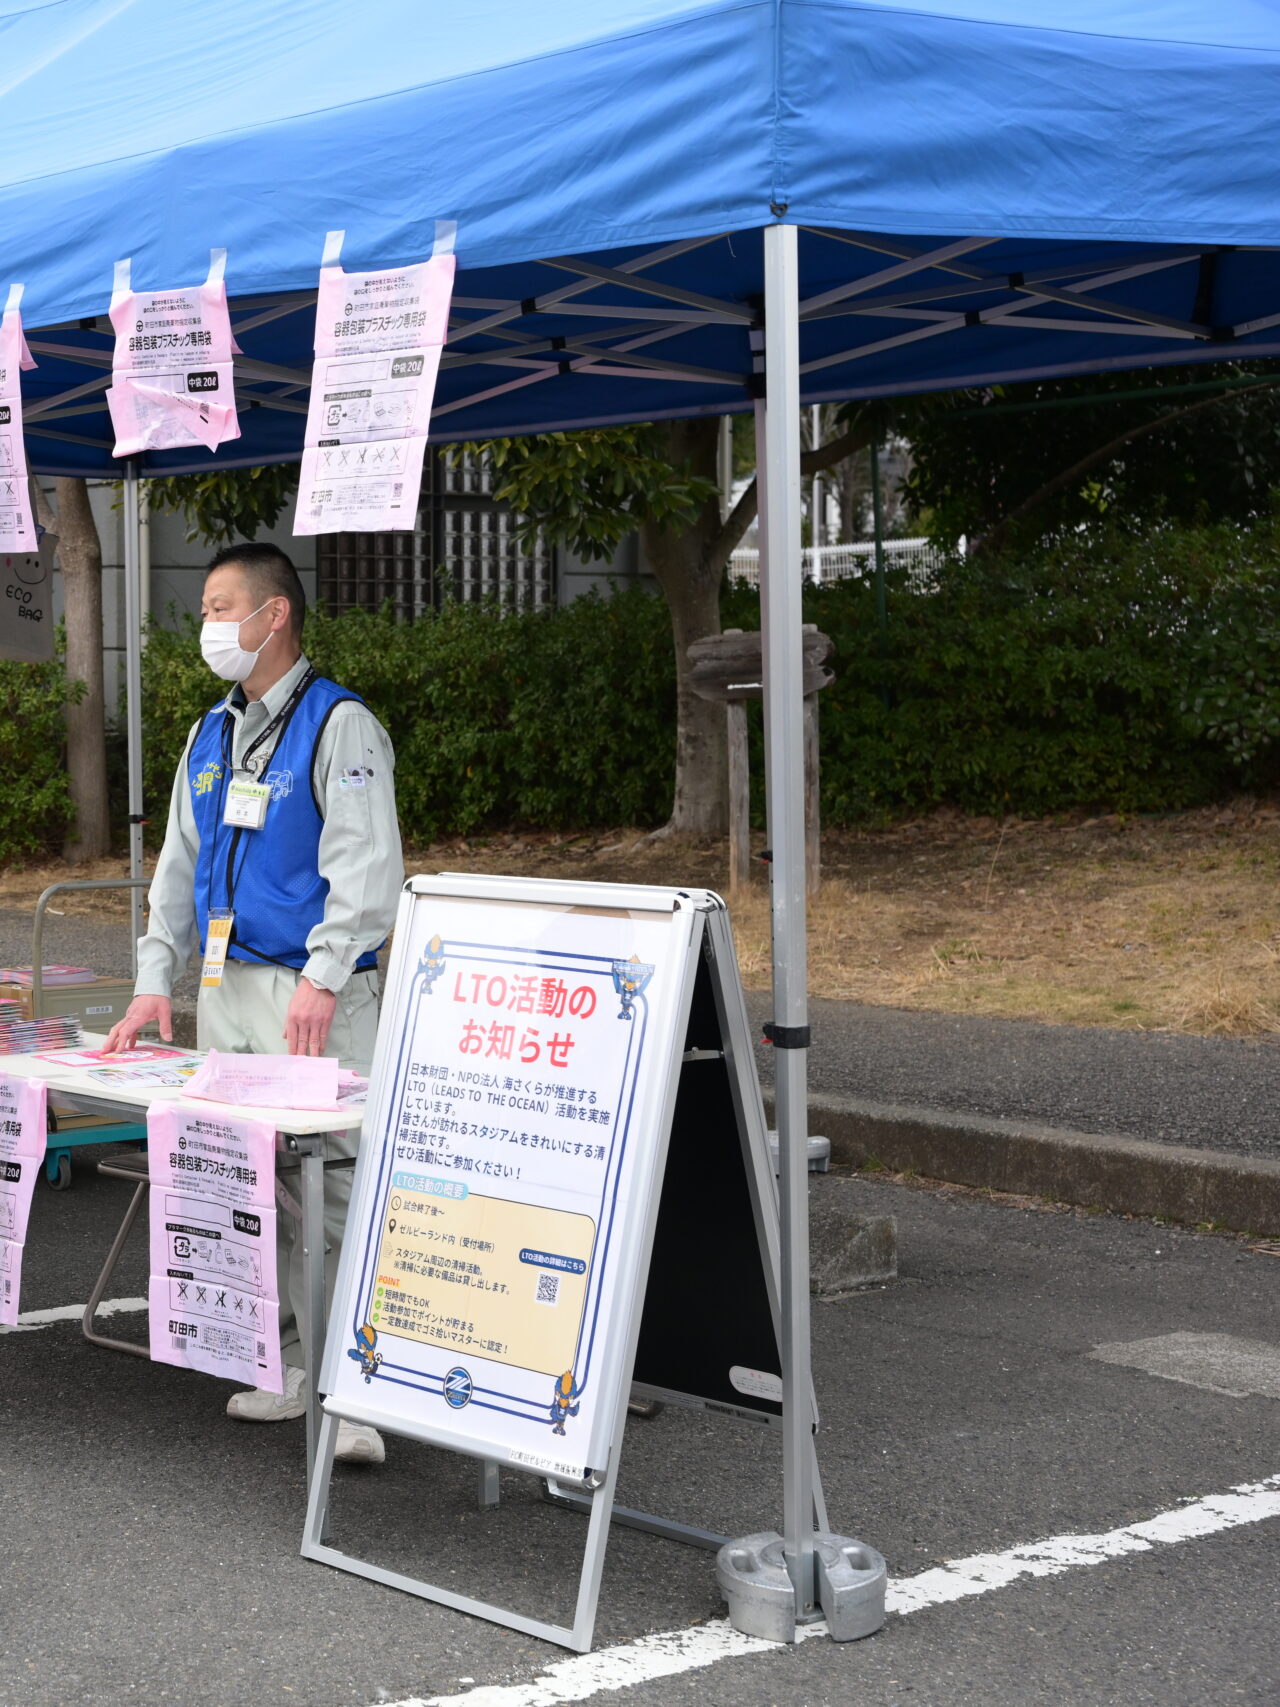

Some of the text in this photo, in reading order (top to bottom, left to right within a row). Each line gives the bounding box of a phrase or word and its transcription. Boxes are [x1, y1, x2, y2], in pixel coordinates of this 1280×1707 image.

[334, 311, 427, 338] 容器包装プラスチック専用袋
[129, 330, 212, 352] 容器包装プラスチック専用袋
[5, 584, 33, 604] ECO
[18, 605, 44, 623] BAG
[452, 971, 597, 1020] LTO活動の
[458, 1018, 575, 1068] お知らせ
[410, 1062, 598, 1105] 日本財団・NPO法人 海さくらが推進する
[405, 1095, 457, 1117] しています。
[469, 1088, 482, 1102] TO
[487, 1092, 507, 1106] THE
[398, 1127, 451, 1150] 掃活動です。
[402, 1110, 606, 1161] 皆さんが訪れるスタジアムをきれいにする清
[169, 1152, 258, 1186] 容器包装プラスチック専用袋
[396, 1145, 521, 1180] ぜひ活動にご参加ください！
[396, 1173, 465, 1199] LTO活動の概要
[521, 1251, 584, 1272] LTO活動の詳細はこちら
[378, 1274, 400, 1287] POINT
[384, 1289, 430, 1308] 短時間でもOK
[169, 1319, 198, 1338] 町田市
[382, 1301, 474, 1333] 活動参加でポイントが貯まる
